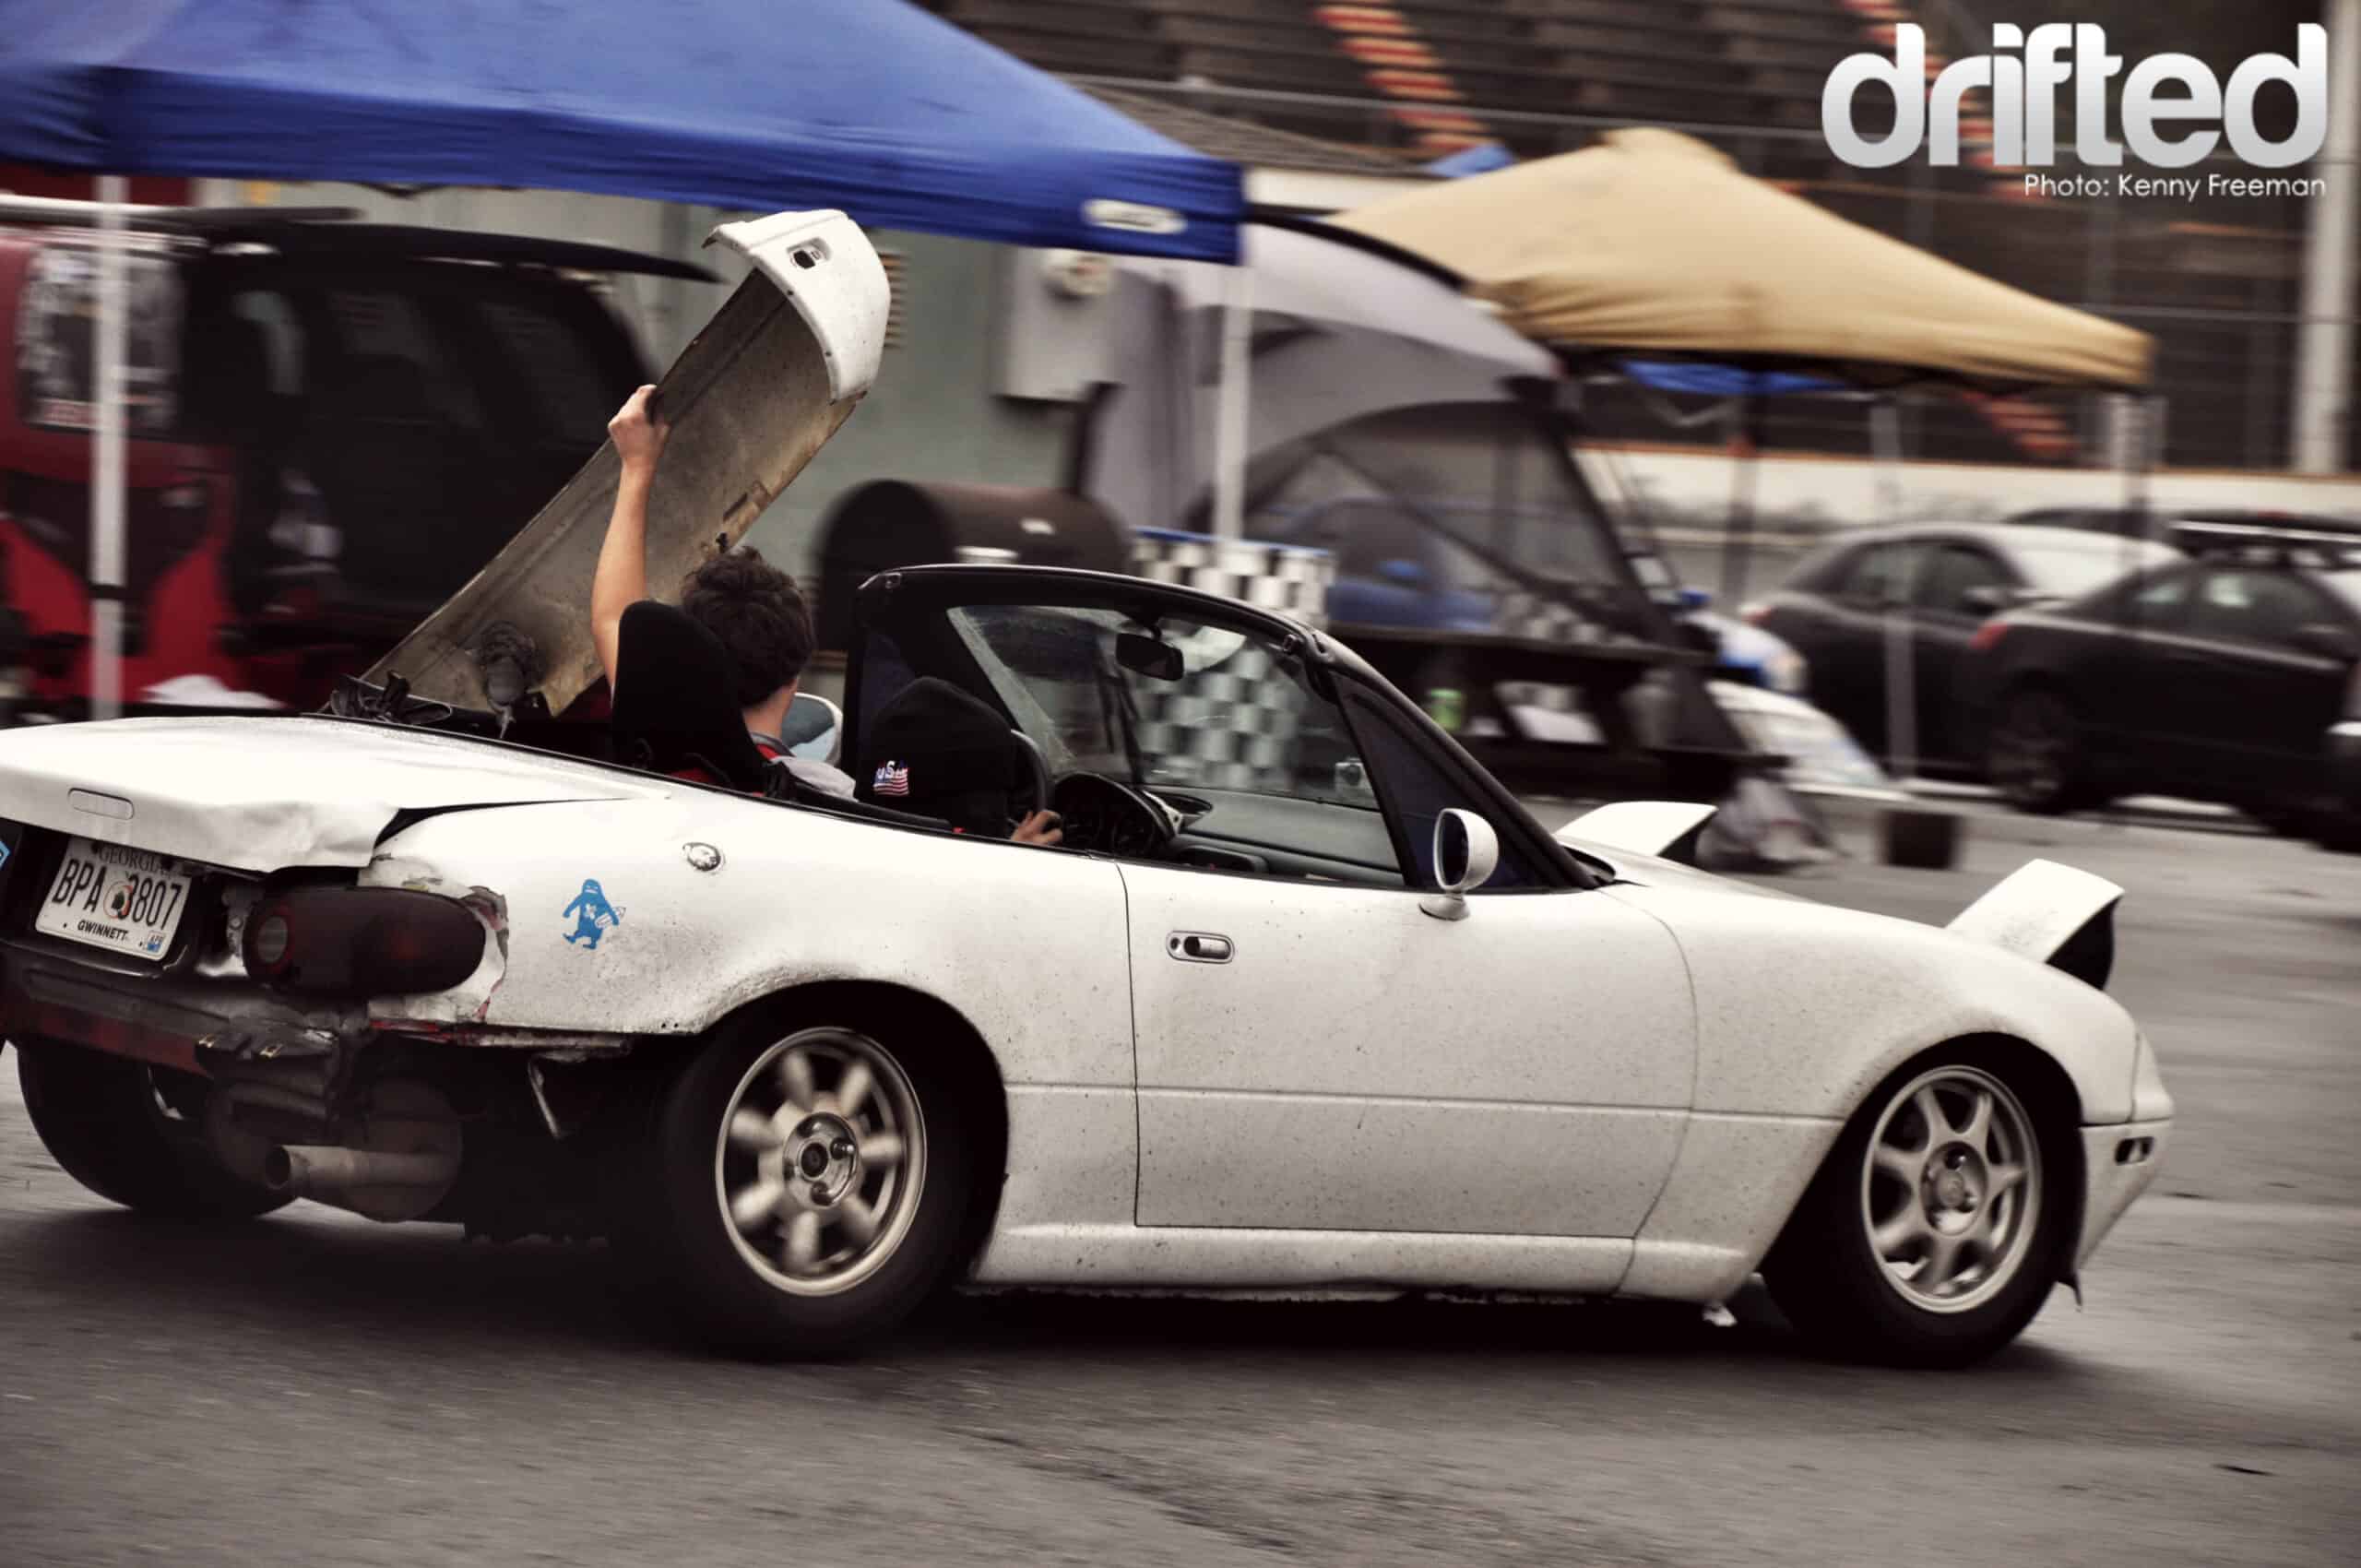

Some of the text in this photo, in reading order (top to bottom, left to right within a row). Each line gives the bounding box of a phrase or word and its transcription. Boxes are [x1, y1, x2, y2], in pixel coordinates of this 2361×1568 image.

[52, 858, 184, 931] BPA 3807
[77, 920, 129, 941] GWINNETT
